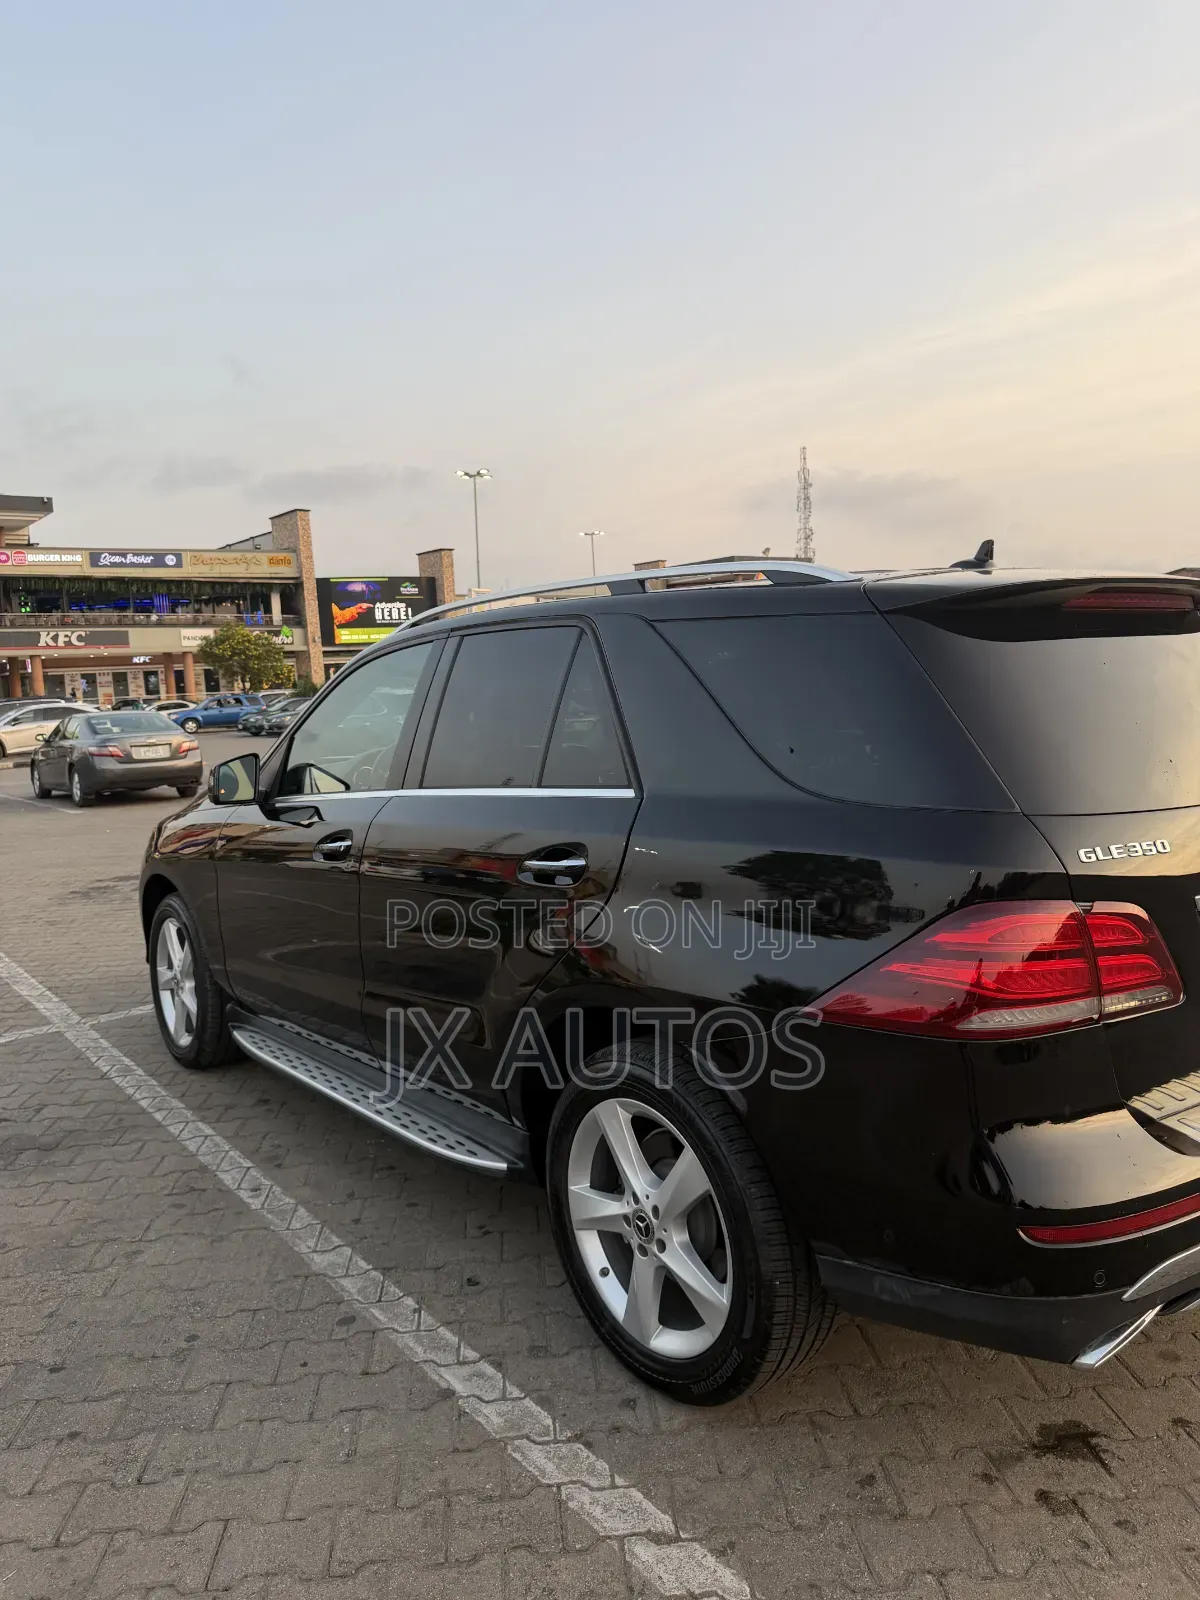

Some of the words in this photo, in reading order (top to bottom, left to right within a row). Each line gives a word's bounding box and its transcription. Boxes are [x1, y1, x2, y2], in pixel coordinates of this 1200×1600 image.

[28, 554, 61, 562] BURGER
[61, 554, 82, 562] KING
[98, 552, 125, 565] Ocean
[126, 553, 154, 564] Basket
[375, 608, 412, 619] HERE!
[38, 631, 86, 646] KFC
[1076, 839, 1171, 863] GLE350
